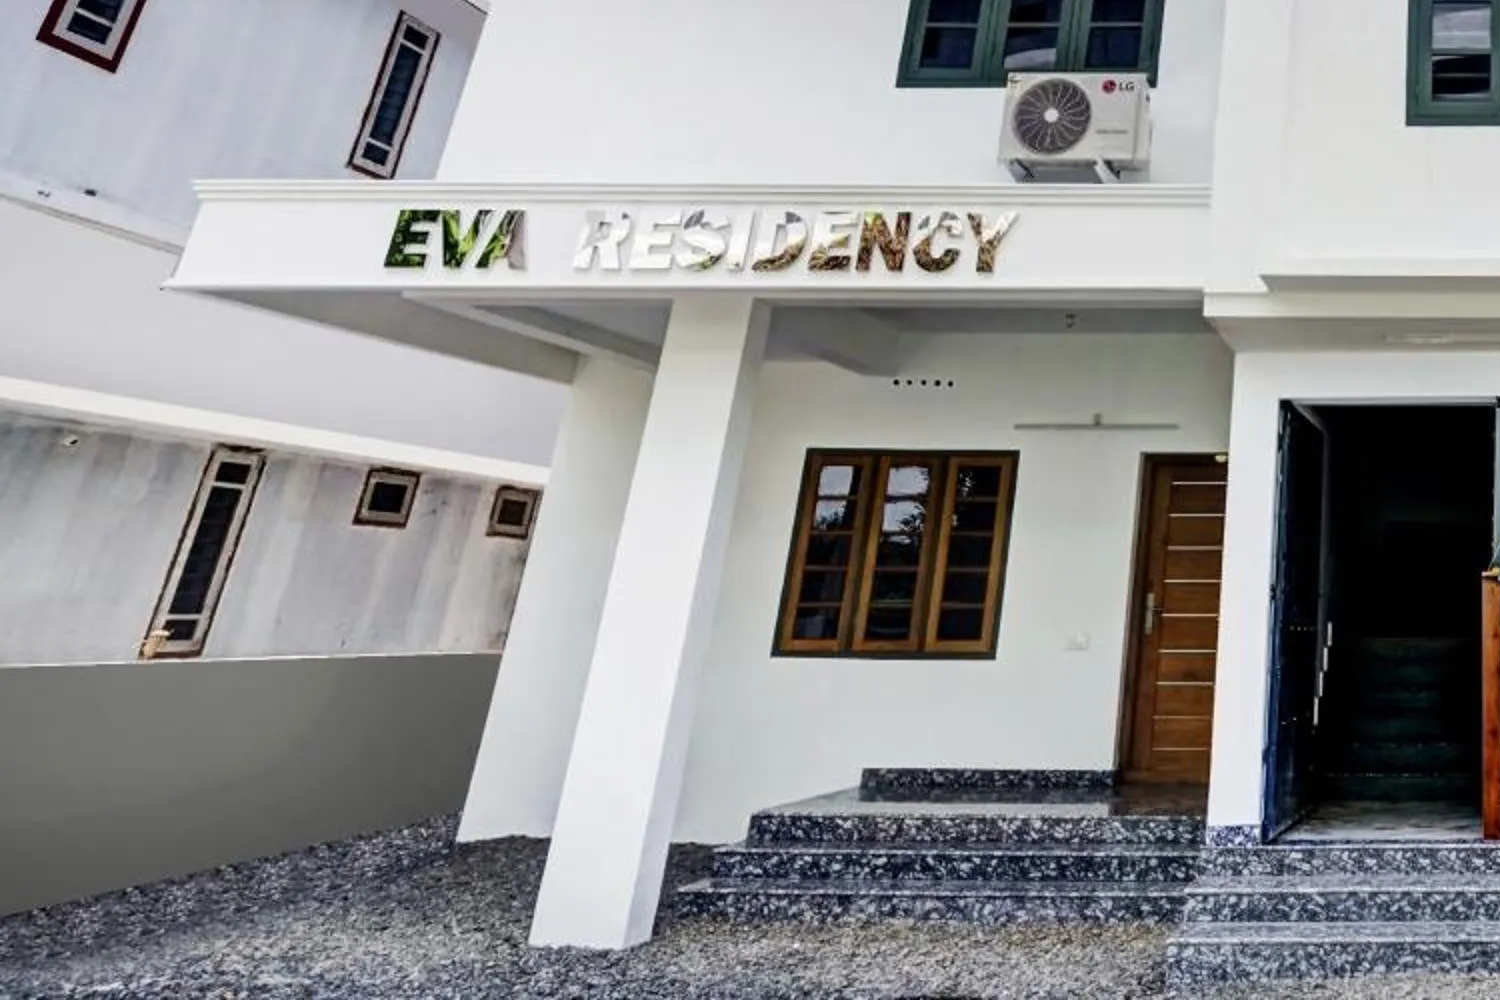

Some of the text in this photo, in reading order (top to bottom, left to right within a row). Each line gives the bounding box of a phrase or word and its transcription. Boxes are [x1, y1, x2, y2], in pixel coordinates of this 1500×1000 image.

[1119, 81, 1135, 92] LG
[383, 208, 1022, 275] EVA RESIDENCY
